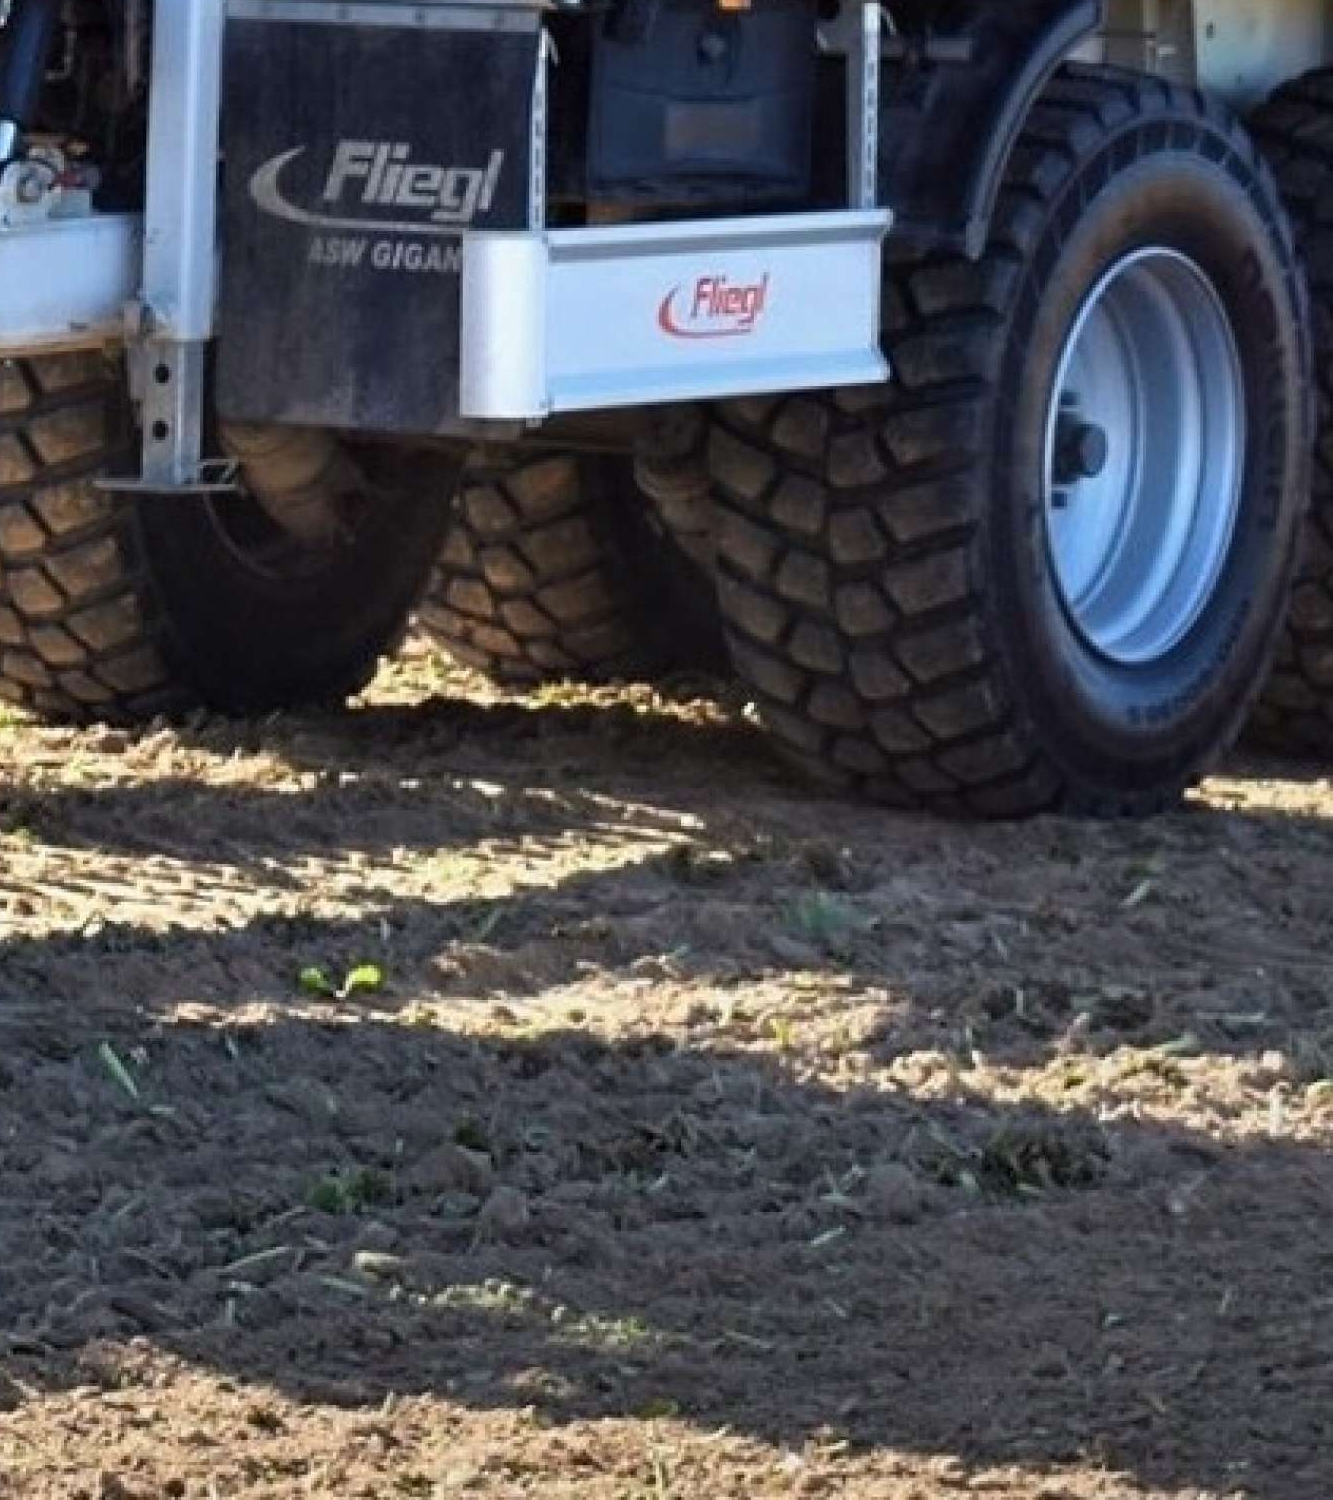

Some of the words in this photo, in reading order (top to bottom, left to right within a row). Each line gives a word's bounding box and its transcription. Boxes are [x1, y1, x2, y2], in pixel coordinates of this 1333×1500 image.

[323, 138, 506, 222] Fliegl
[308, 236, 369, 265] ASW
[690, 271, 770, 325] Fliegl
